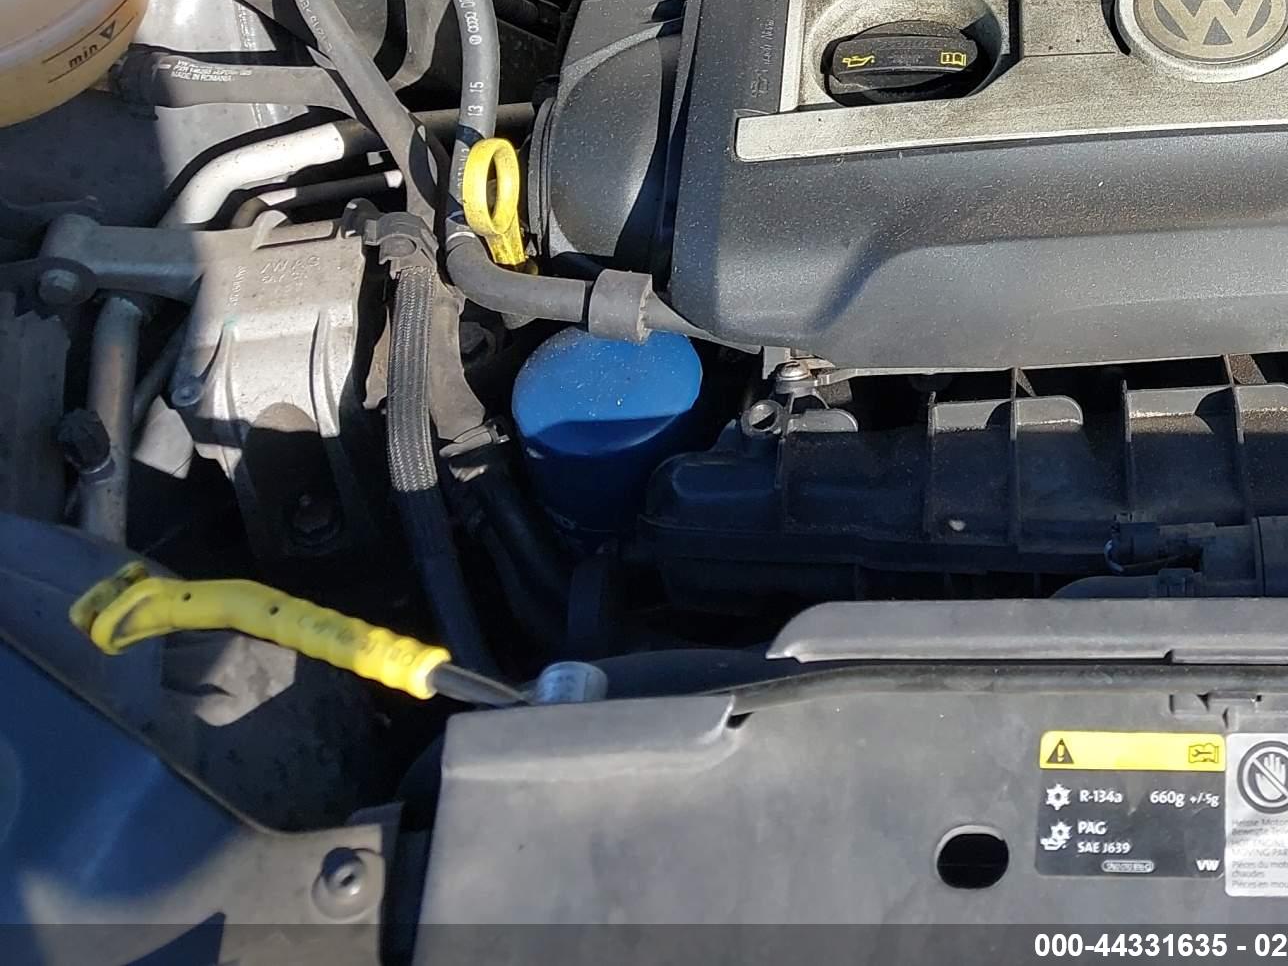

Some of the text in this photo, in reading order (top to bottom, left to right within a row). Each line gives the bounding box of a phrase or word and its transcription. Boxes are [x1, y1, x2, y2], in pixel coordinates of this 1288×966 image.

[68, 43, 99, 68] min
[469, 81, 484, 93] 15
[468, 105, 484, 116] 13
[1079, 789, 1124, 803] R-134a
[1149, 789, 1185, 808] 660g
[1078, 821, 1108, 835] PAG
[1077, 841, 1131, 854] SAE J639
[1196, 859, 1220, 871] VW
